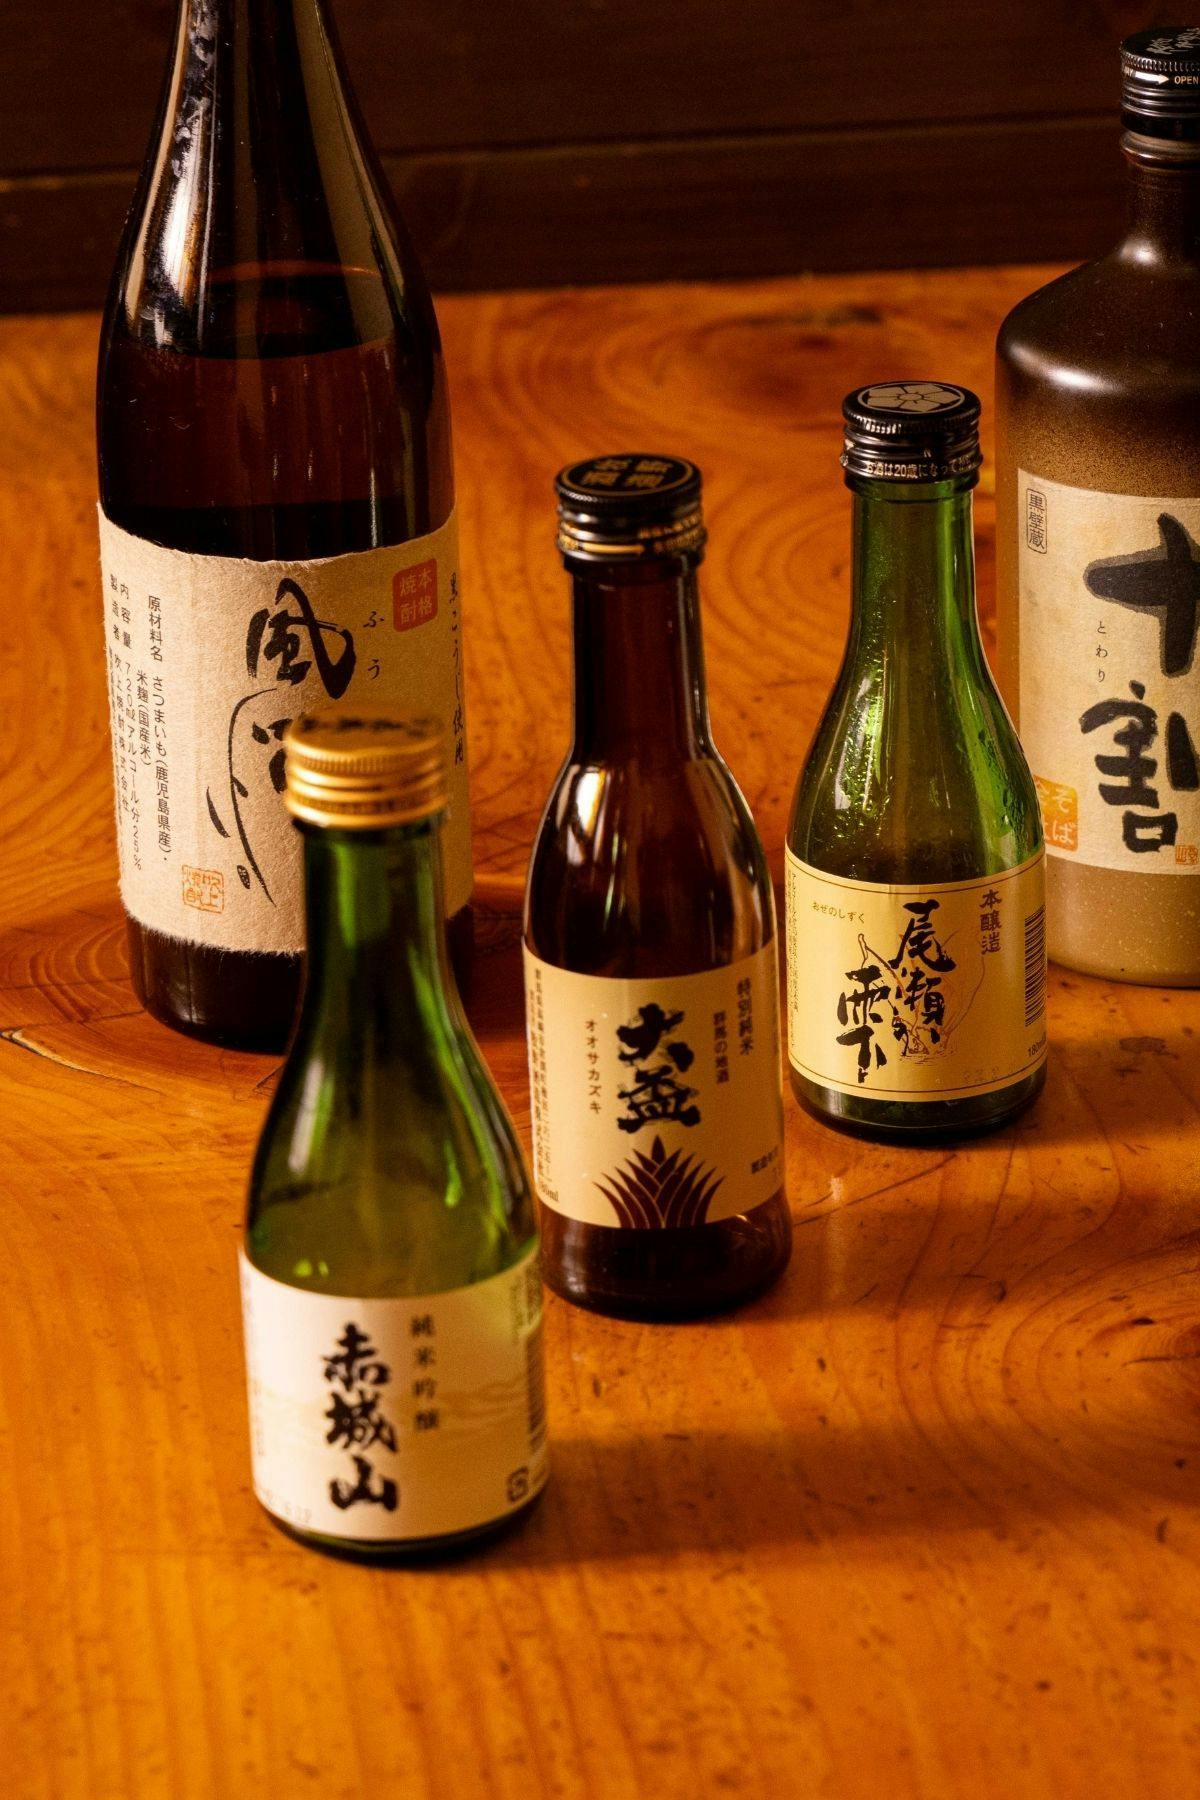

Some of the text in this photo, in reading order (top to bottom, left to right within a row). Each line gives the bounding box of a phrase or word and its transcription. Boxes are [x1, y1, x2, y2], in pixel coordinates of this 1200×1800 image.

[1174, 75, 1199, 85] OPEN
[1028, 493, 1046, 550] 黒壁蔵
[148, 594, 163, 662] 原材料名
[1095, 620, 1110, 684] とわり
[811, 901, 866, 925] おぜのしずく
[979, 889, 1002, 955] 本醸造
[585, 1019, 602, 1115] オオサカズキ
[322, 1320, 398, 1513] 赤城山
